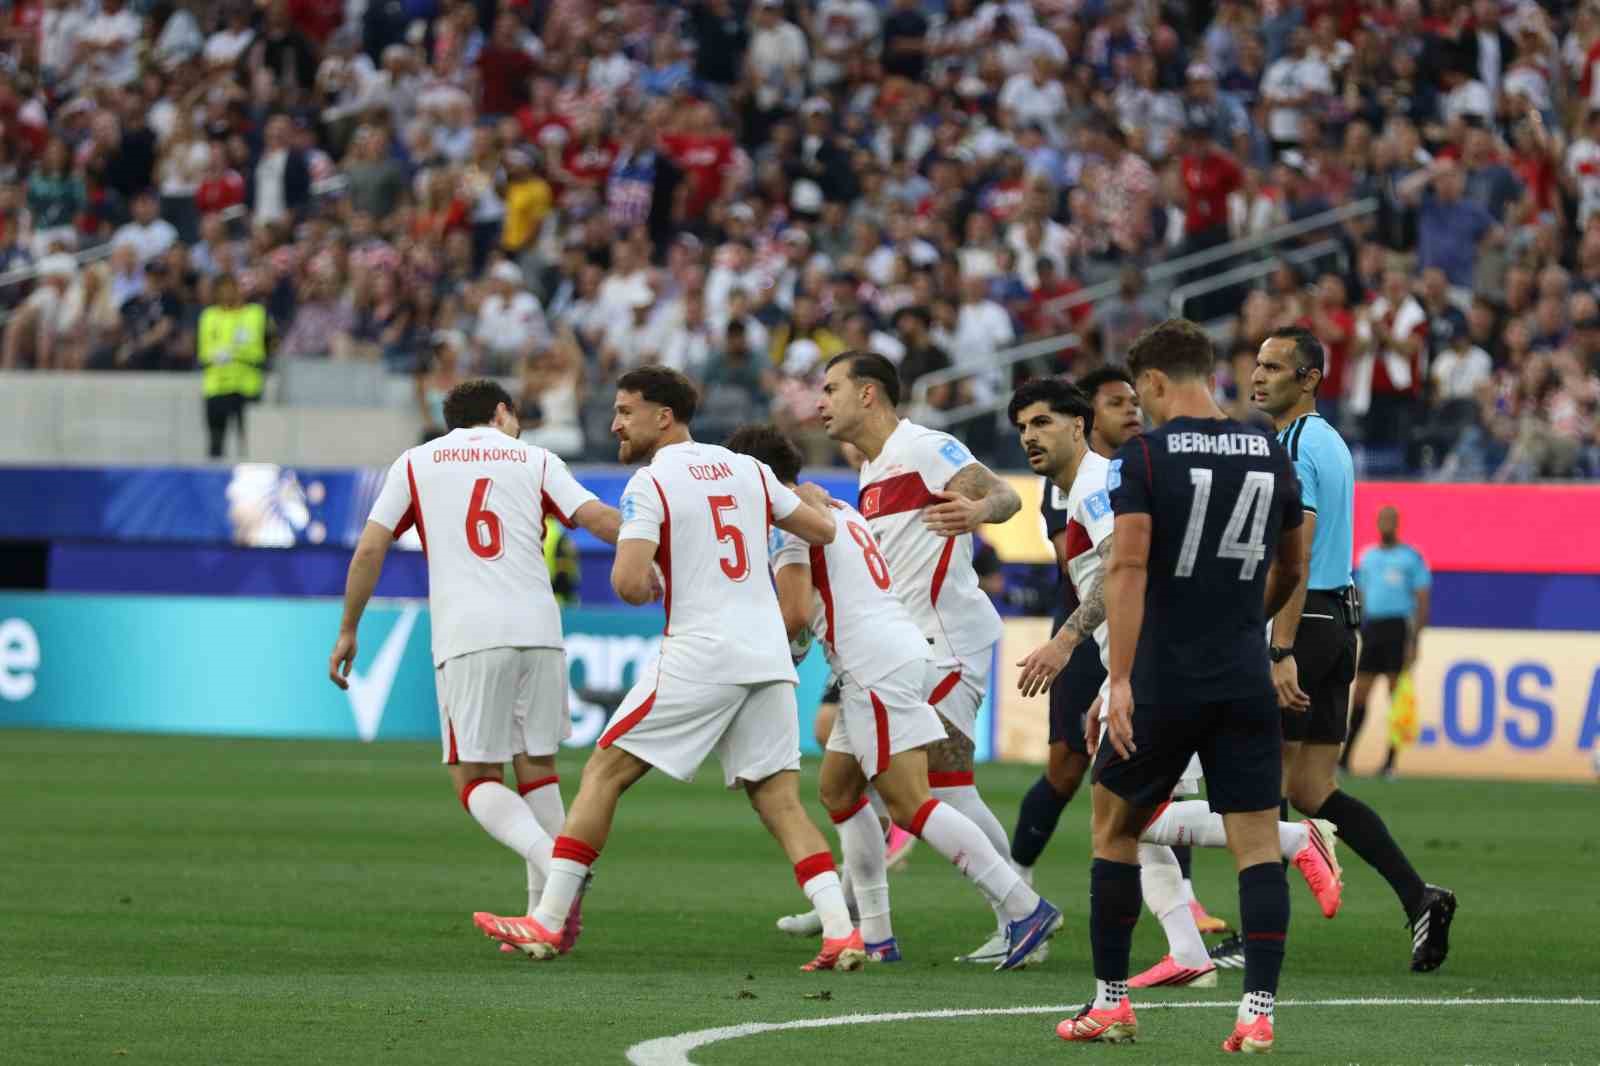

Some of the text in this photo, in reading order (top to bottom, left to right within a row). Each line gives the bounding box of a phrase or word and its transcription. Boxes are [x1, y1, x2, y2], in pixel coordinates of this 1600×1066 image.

[433, 448, 480, 464] ORKUN
[1167, 432, 1271, 457] BERHALTER
[465, 478, 504, 561] 6
[707, 495, 750, 583] 5
[847, 520, 893, 591] 8
[1174, 467, 1275, 581] 14
[1419, 659, 1555, 750] OS
